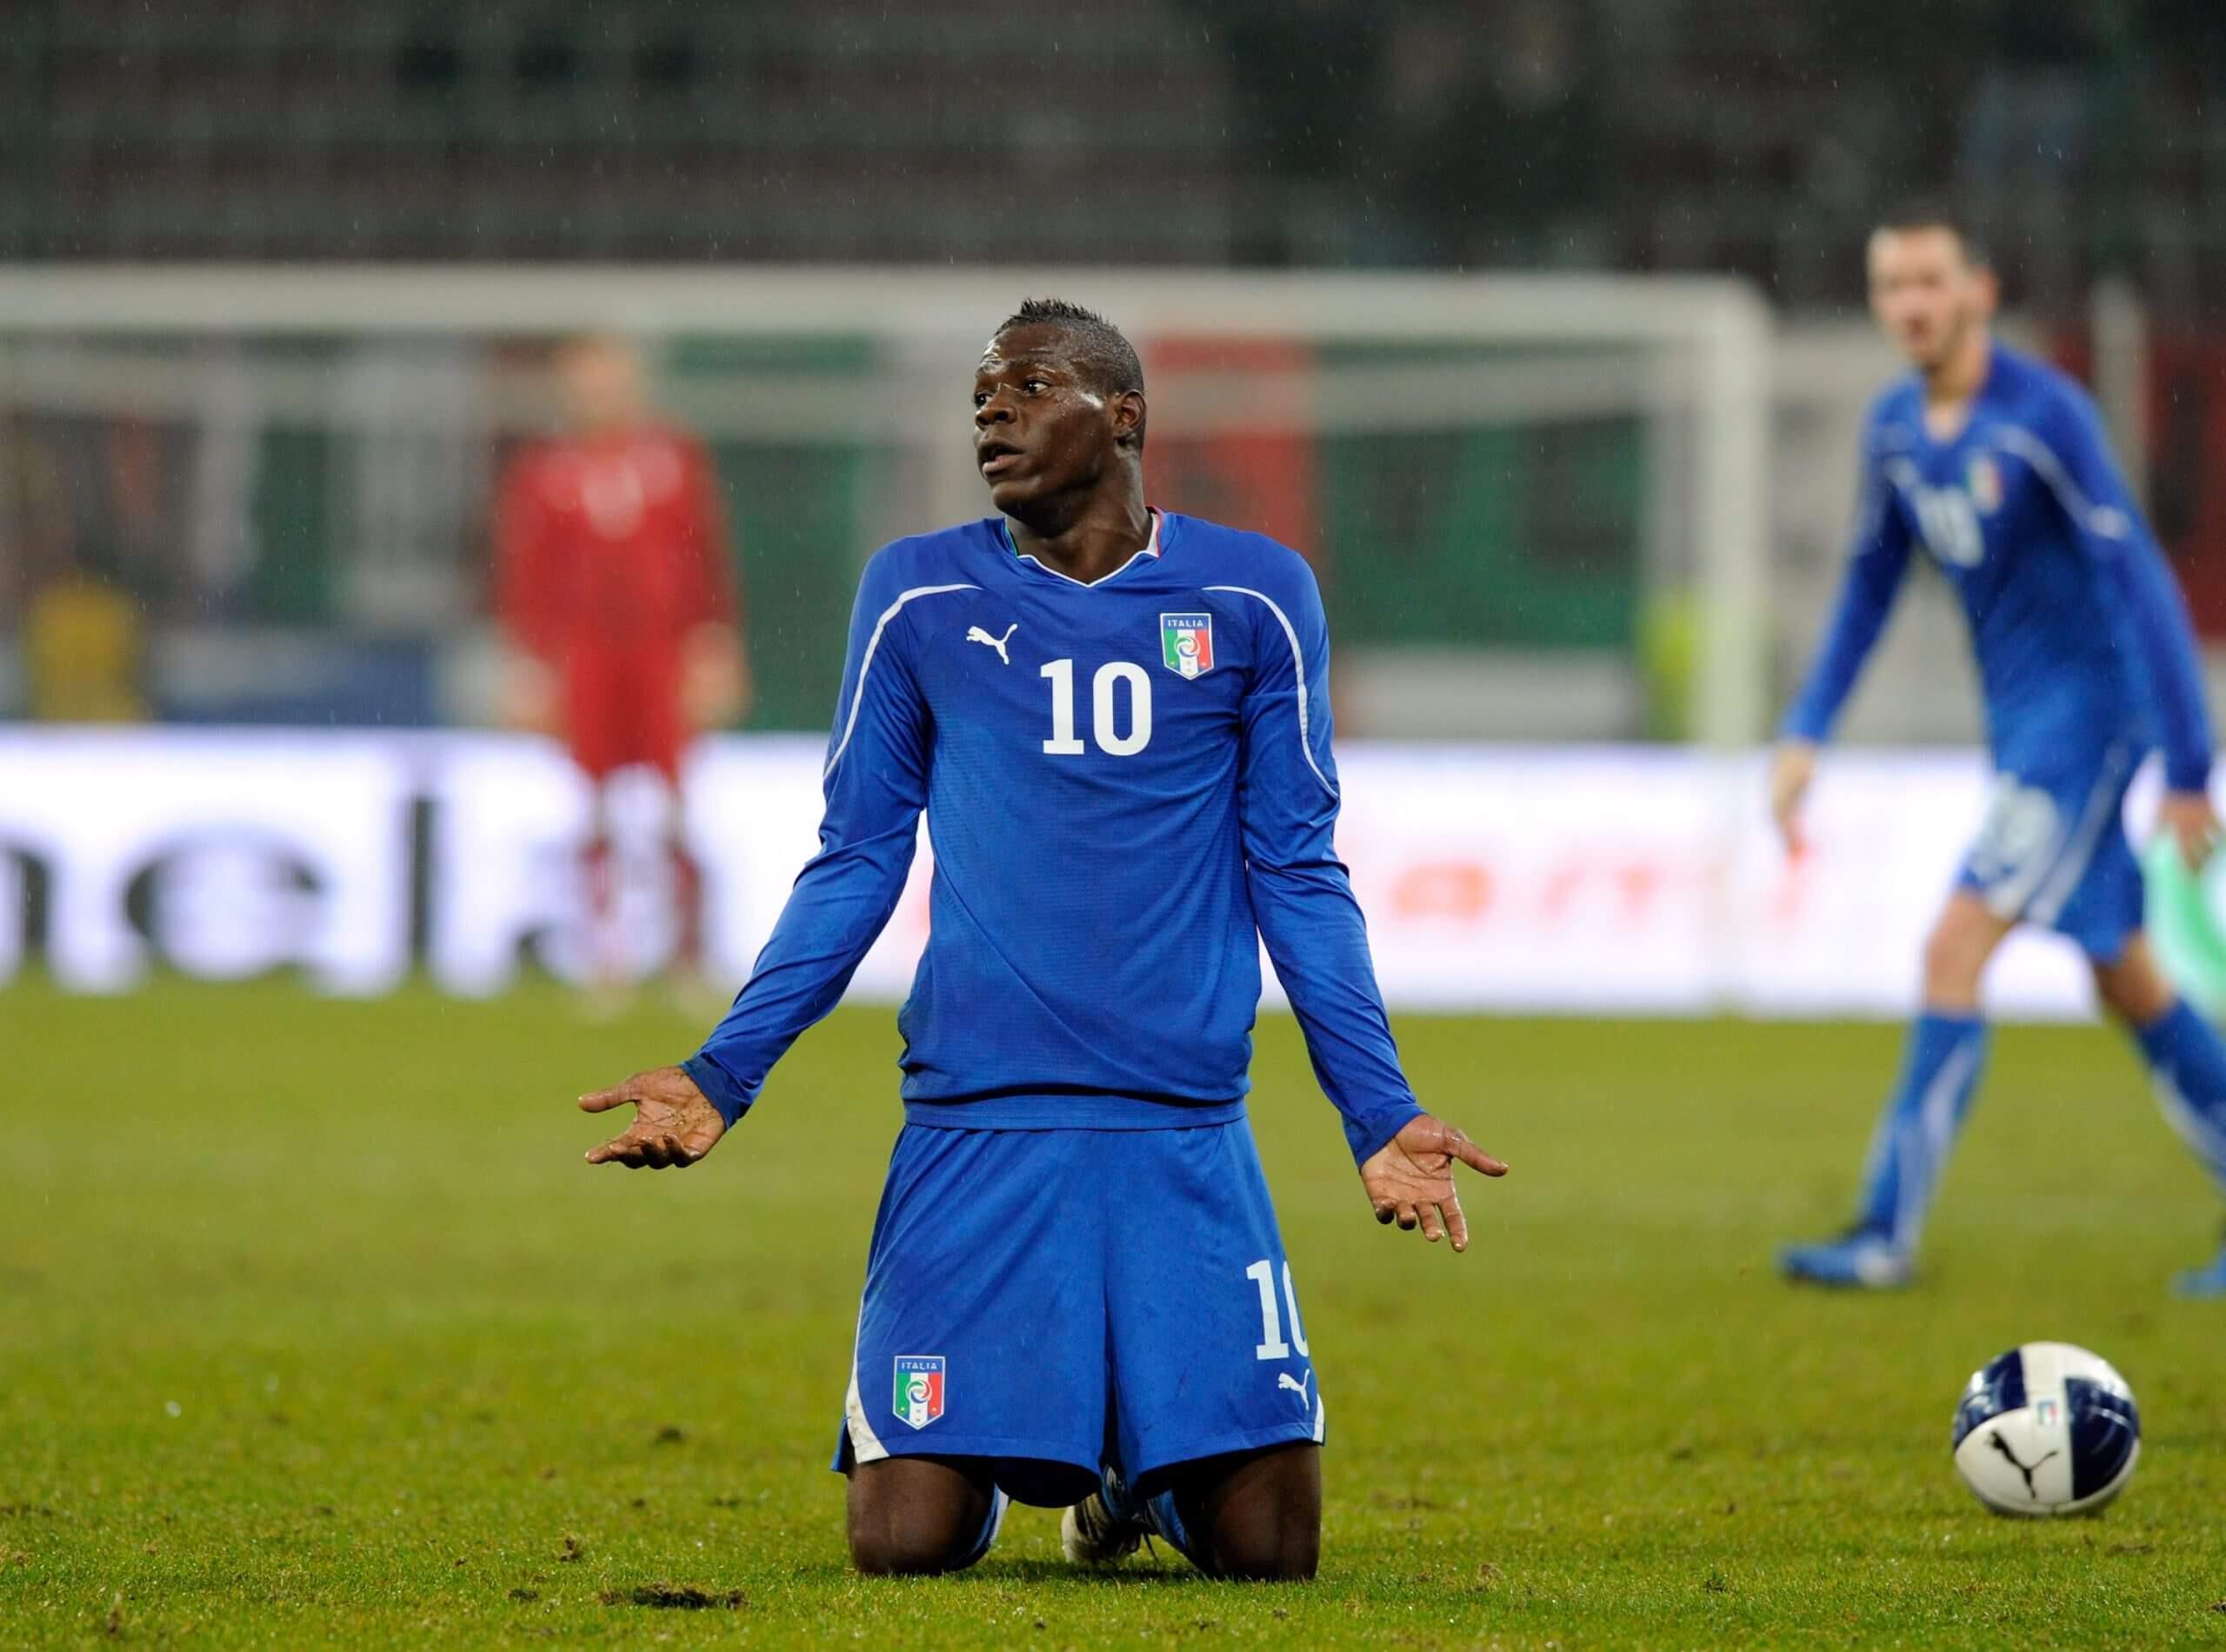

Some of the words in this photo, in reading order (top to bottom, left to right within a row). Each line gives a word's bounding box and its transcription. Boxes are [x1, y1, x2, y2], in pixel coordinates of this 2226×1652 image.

[1167, 619, 1204, 628] ITALIA
[1040, 658, 1151, 756] 10
[901, 1362, 938, 1371] ITALIA
